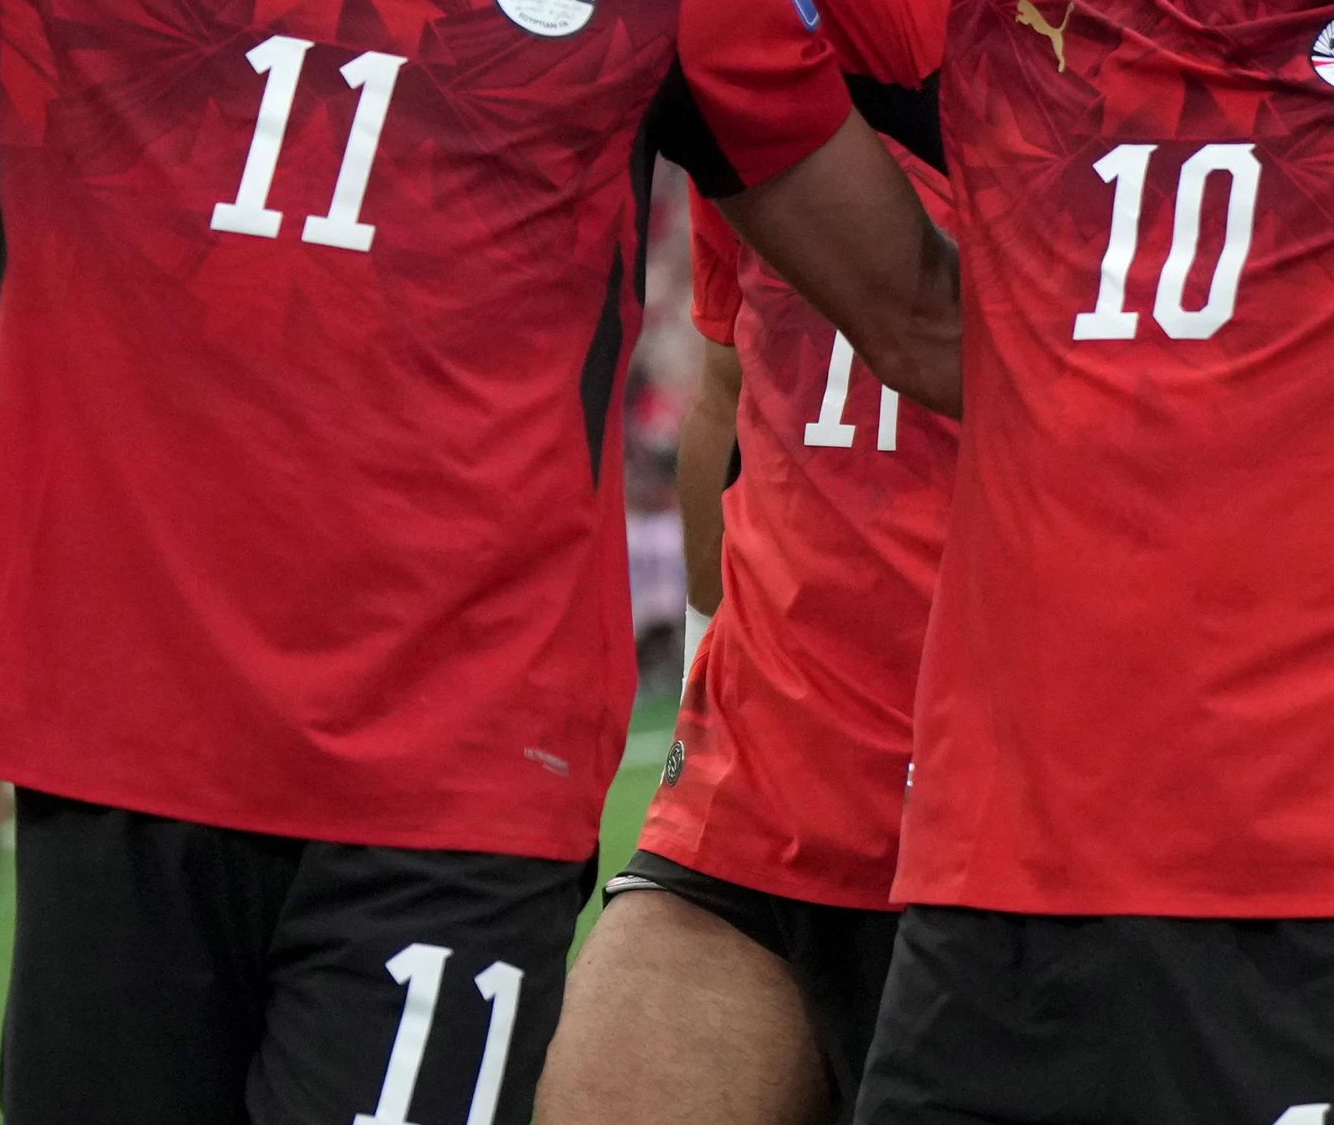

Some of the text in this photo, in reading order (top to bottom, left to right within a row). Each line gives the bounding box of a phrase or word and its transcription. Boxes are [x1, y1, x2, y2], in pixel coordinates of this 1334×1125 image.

[210, 35, 408, 252] 11
[1072, 143, 1262, 341] 10
[350, 942, 525, 1125] 11
